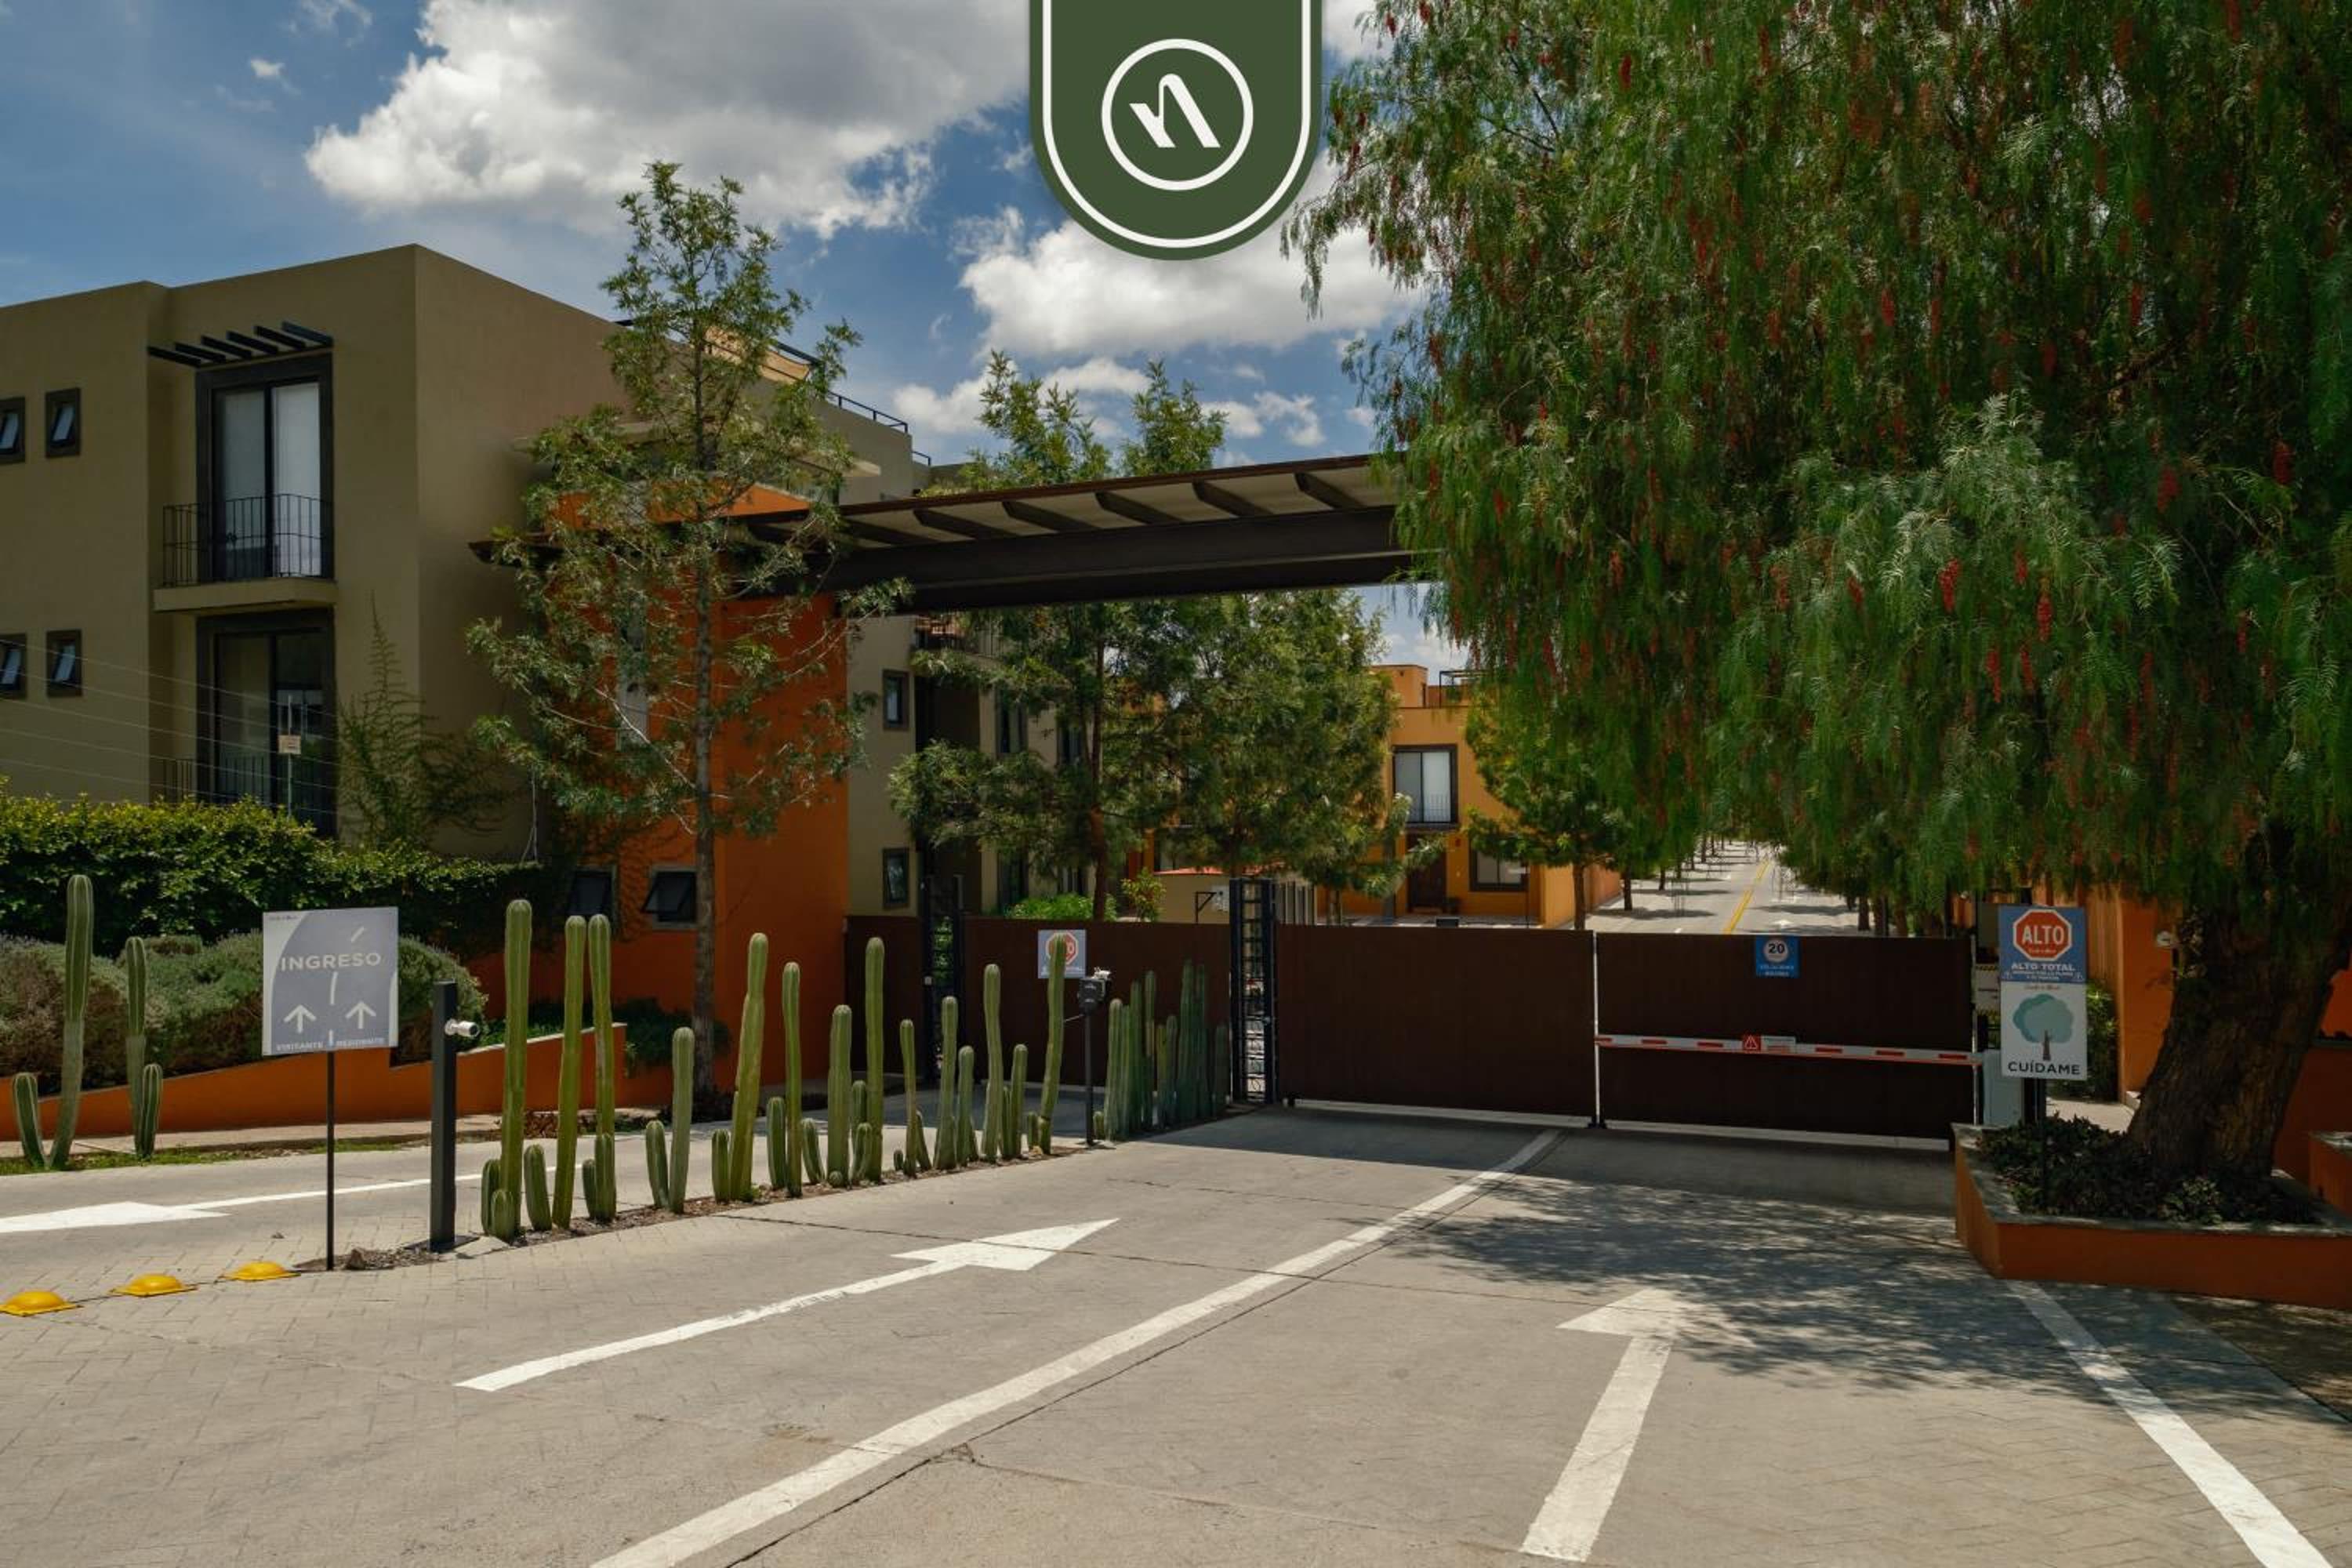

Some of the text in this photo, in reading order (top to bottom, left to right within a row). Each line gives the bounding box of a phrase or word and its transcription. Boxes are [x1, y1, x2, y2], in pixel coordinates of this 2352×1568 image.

[2021, 925, 2064, 945] ALTO
[1768, 943, 1785, 954] 20
[281, 952, 382, 971] INGRESO
[2011, 962, 2076, 972] ALTO TOTAL
[2007, 1061, 2081, 1076] CUÍDAME
